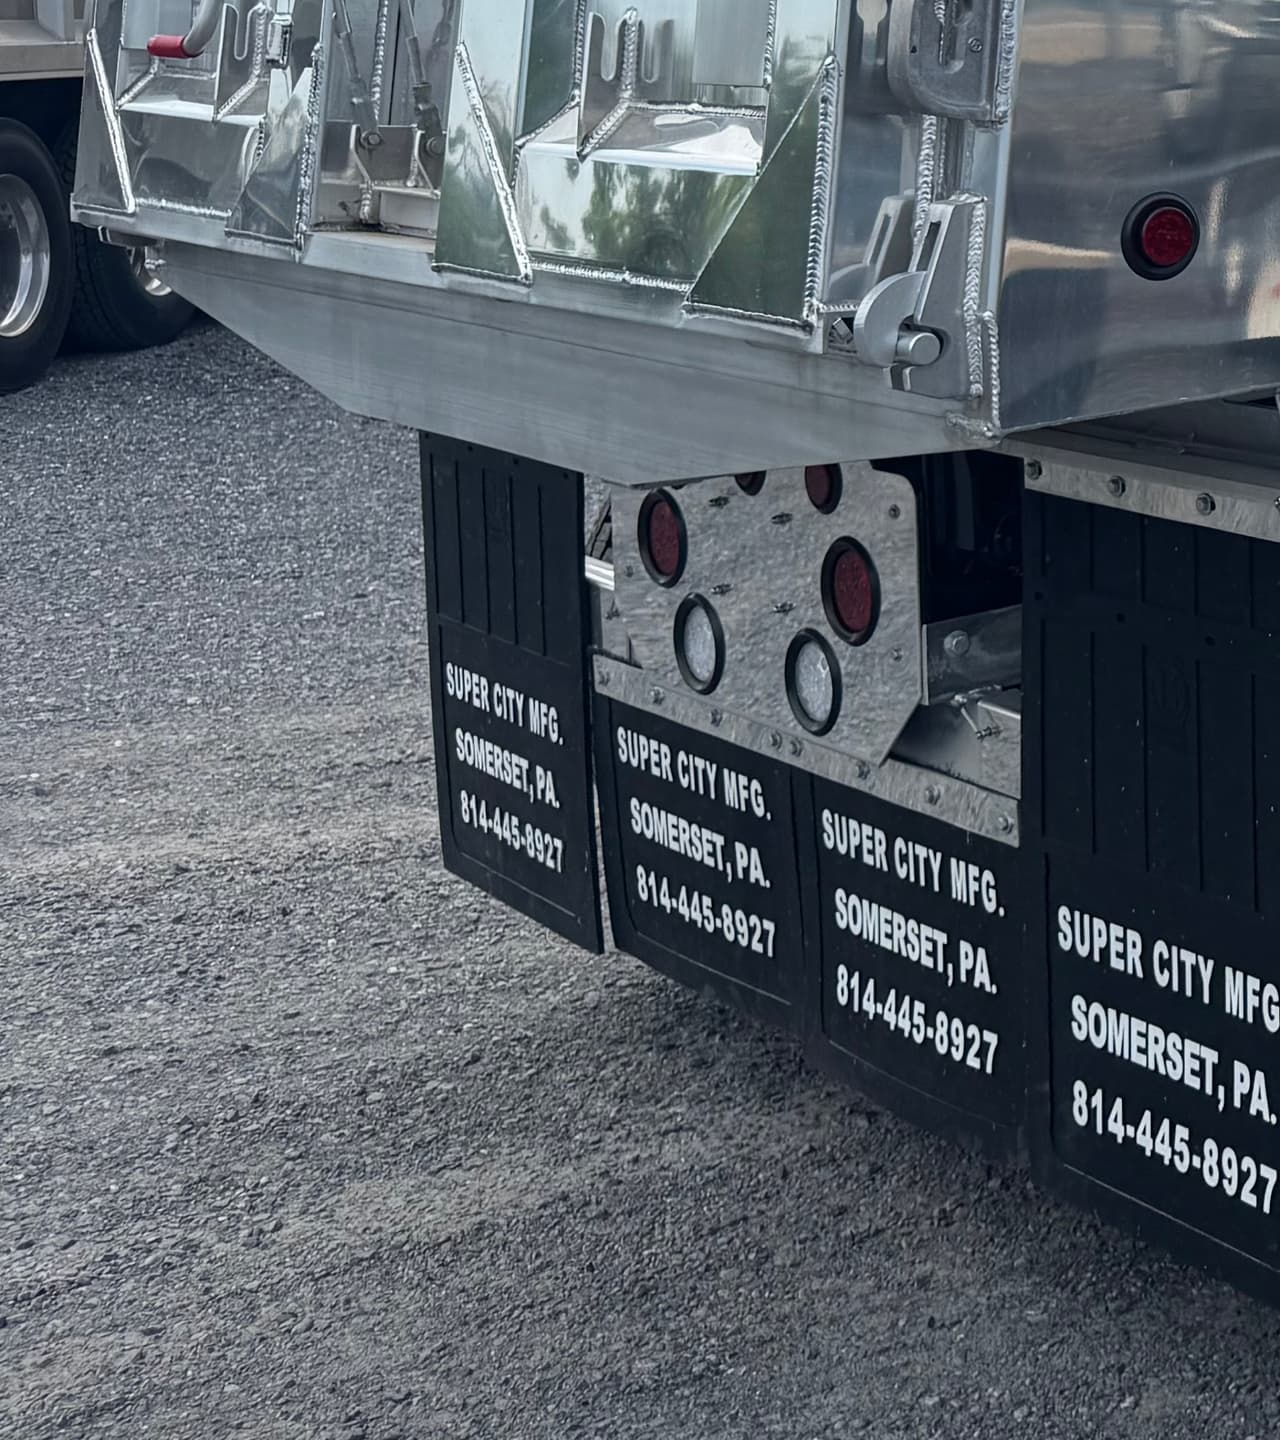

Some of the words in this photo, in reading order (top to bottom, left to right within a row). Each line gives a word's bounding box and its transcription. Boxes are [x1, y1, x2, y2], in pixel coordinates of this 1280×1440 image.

[445, 662, 490, 713] SUPER
[493, 682, 524, 727] CITY
[528, 697, 564, 746] MFG.
[455, 727, 534, 804] SOMERSET,
[535, 764, 560, 809] PA.
[616, 726, 674, 782] SUPER
[677, 750, 717, 800] CITY
[722, 767, 772, 821] MFG.
[460, 789, 563, 873] 814-445-8927
[630, 797, 733, 883] SOMERSET,
[734, 841, 771, 889] PA.
[821, 808, 889, 872] SUPER
[894, 836, 942, 892] CITY
[950, 857, 1005, 917] MFG.
[636, 864, 776, 958] 814-445-8927
[834, 887, 954, 987] SOMERSET,
[959, 939, 998, 995] PA.
[1057, 905, 1144, 979] SUPER
[1152, 939, 1215, 1005] CITY
[836, 963, 998, 1075] 814-445-8927
[1071, 994, 1225, 1113] SOMERSET,
[1233, 1059, 1277, 1125] PA.
[1072, 1079, 1278, 1215] 814-445-8927
